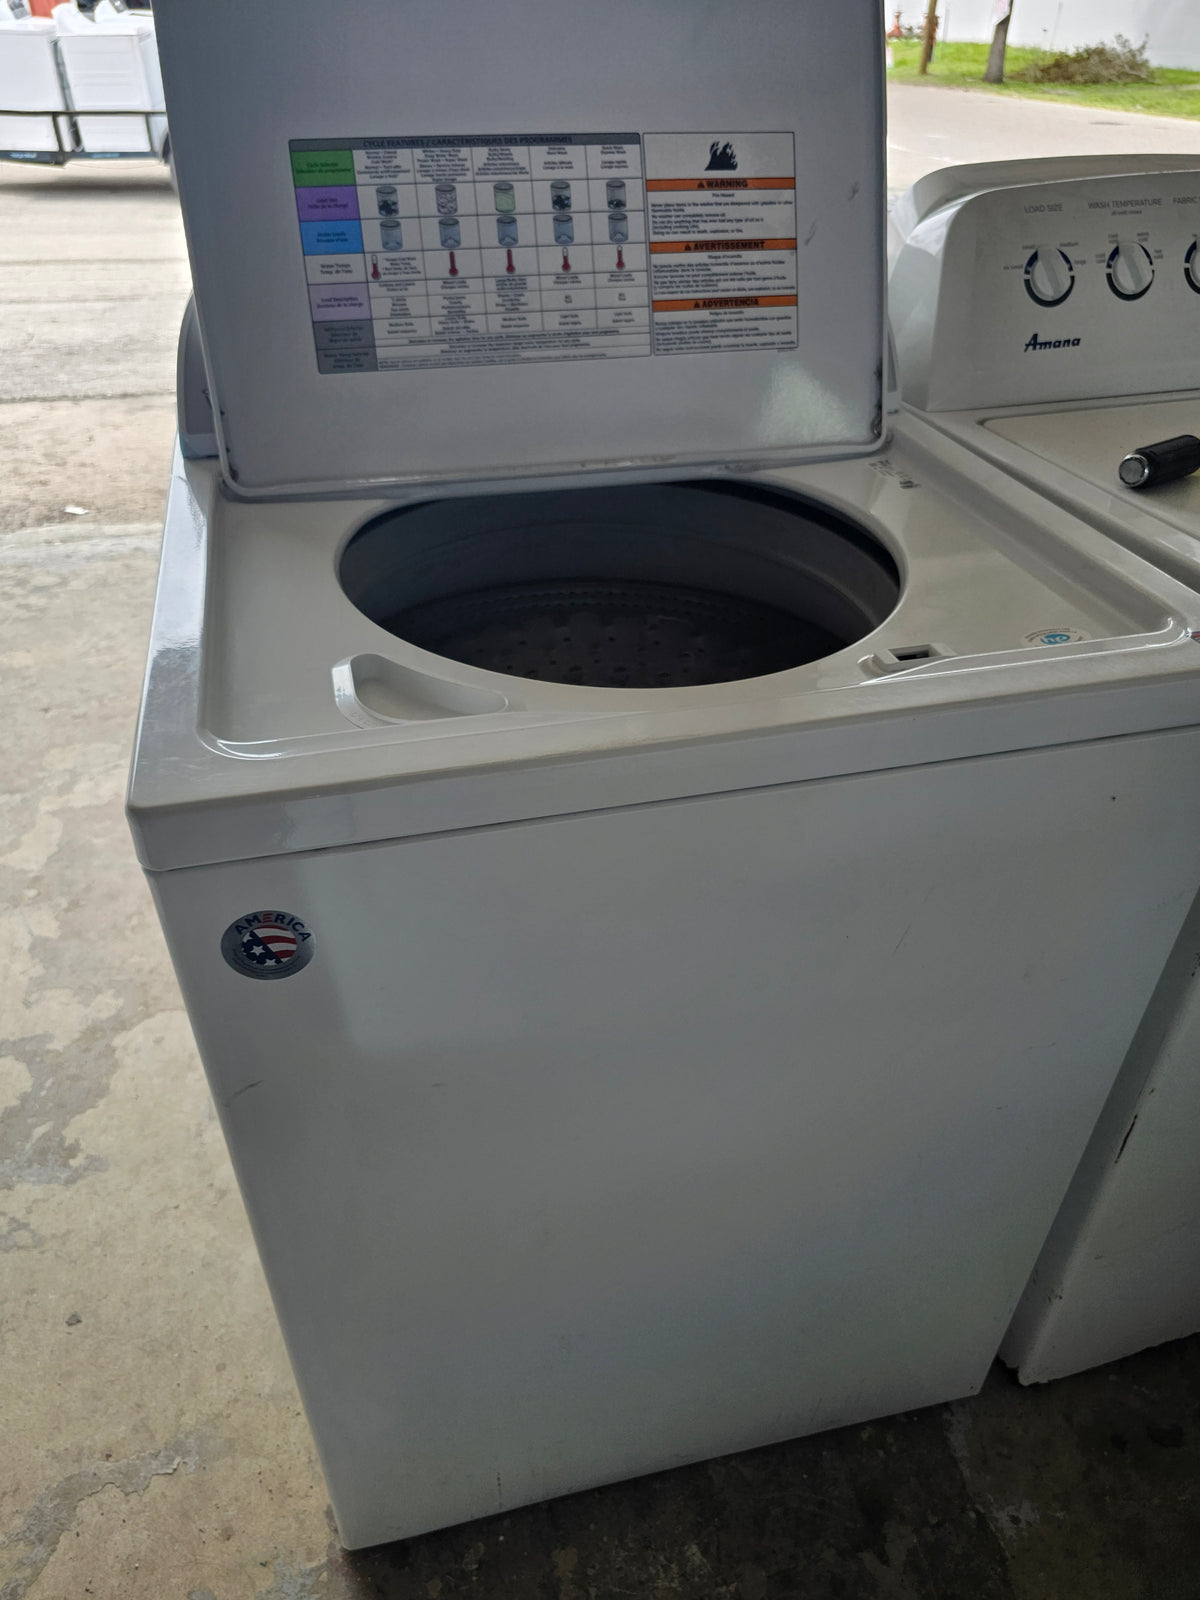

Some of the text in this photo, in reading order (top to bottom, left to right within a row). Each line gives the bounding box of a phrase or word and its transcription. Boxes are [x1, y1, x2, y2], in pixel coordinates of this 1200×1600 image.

[363, 139, 385, 148] CYCLE
[706, 179, 748, 189] WARNING
[1088, 197, 1162, 209] WASH TEMPERATURE
[1173, 195, 1198, 205] FABRIC
[1023, 203, 1064, 214] LOAD SIZE
[693, 241, 765, 251] AVERTISSEMENT
[702, 298, 759, 309] ADVERTENCIA
[1024, 333, 1081, 352] Amana
[235, 913, 311, 942] AMERICA
